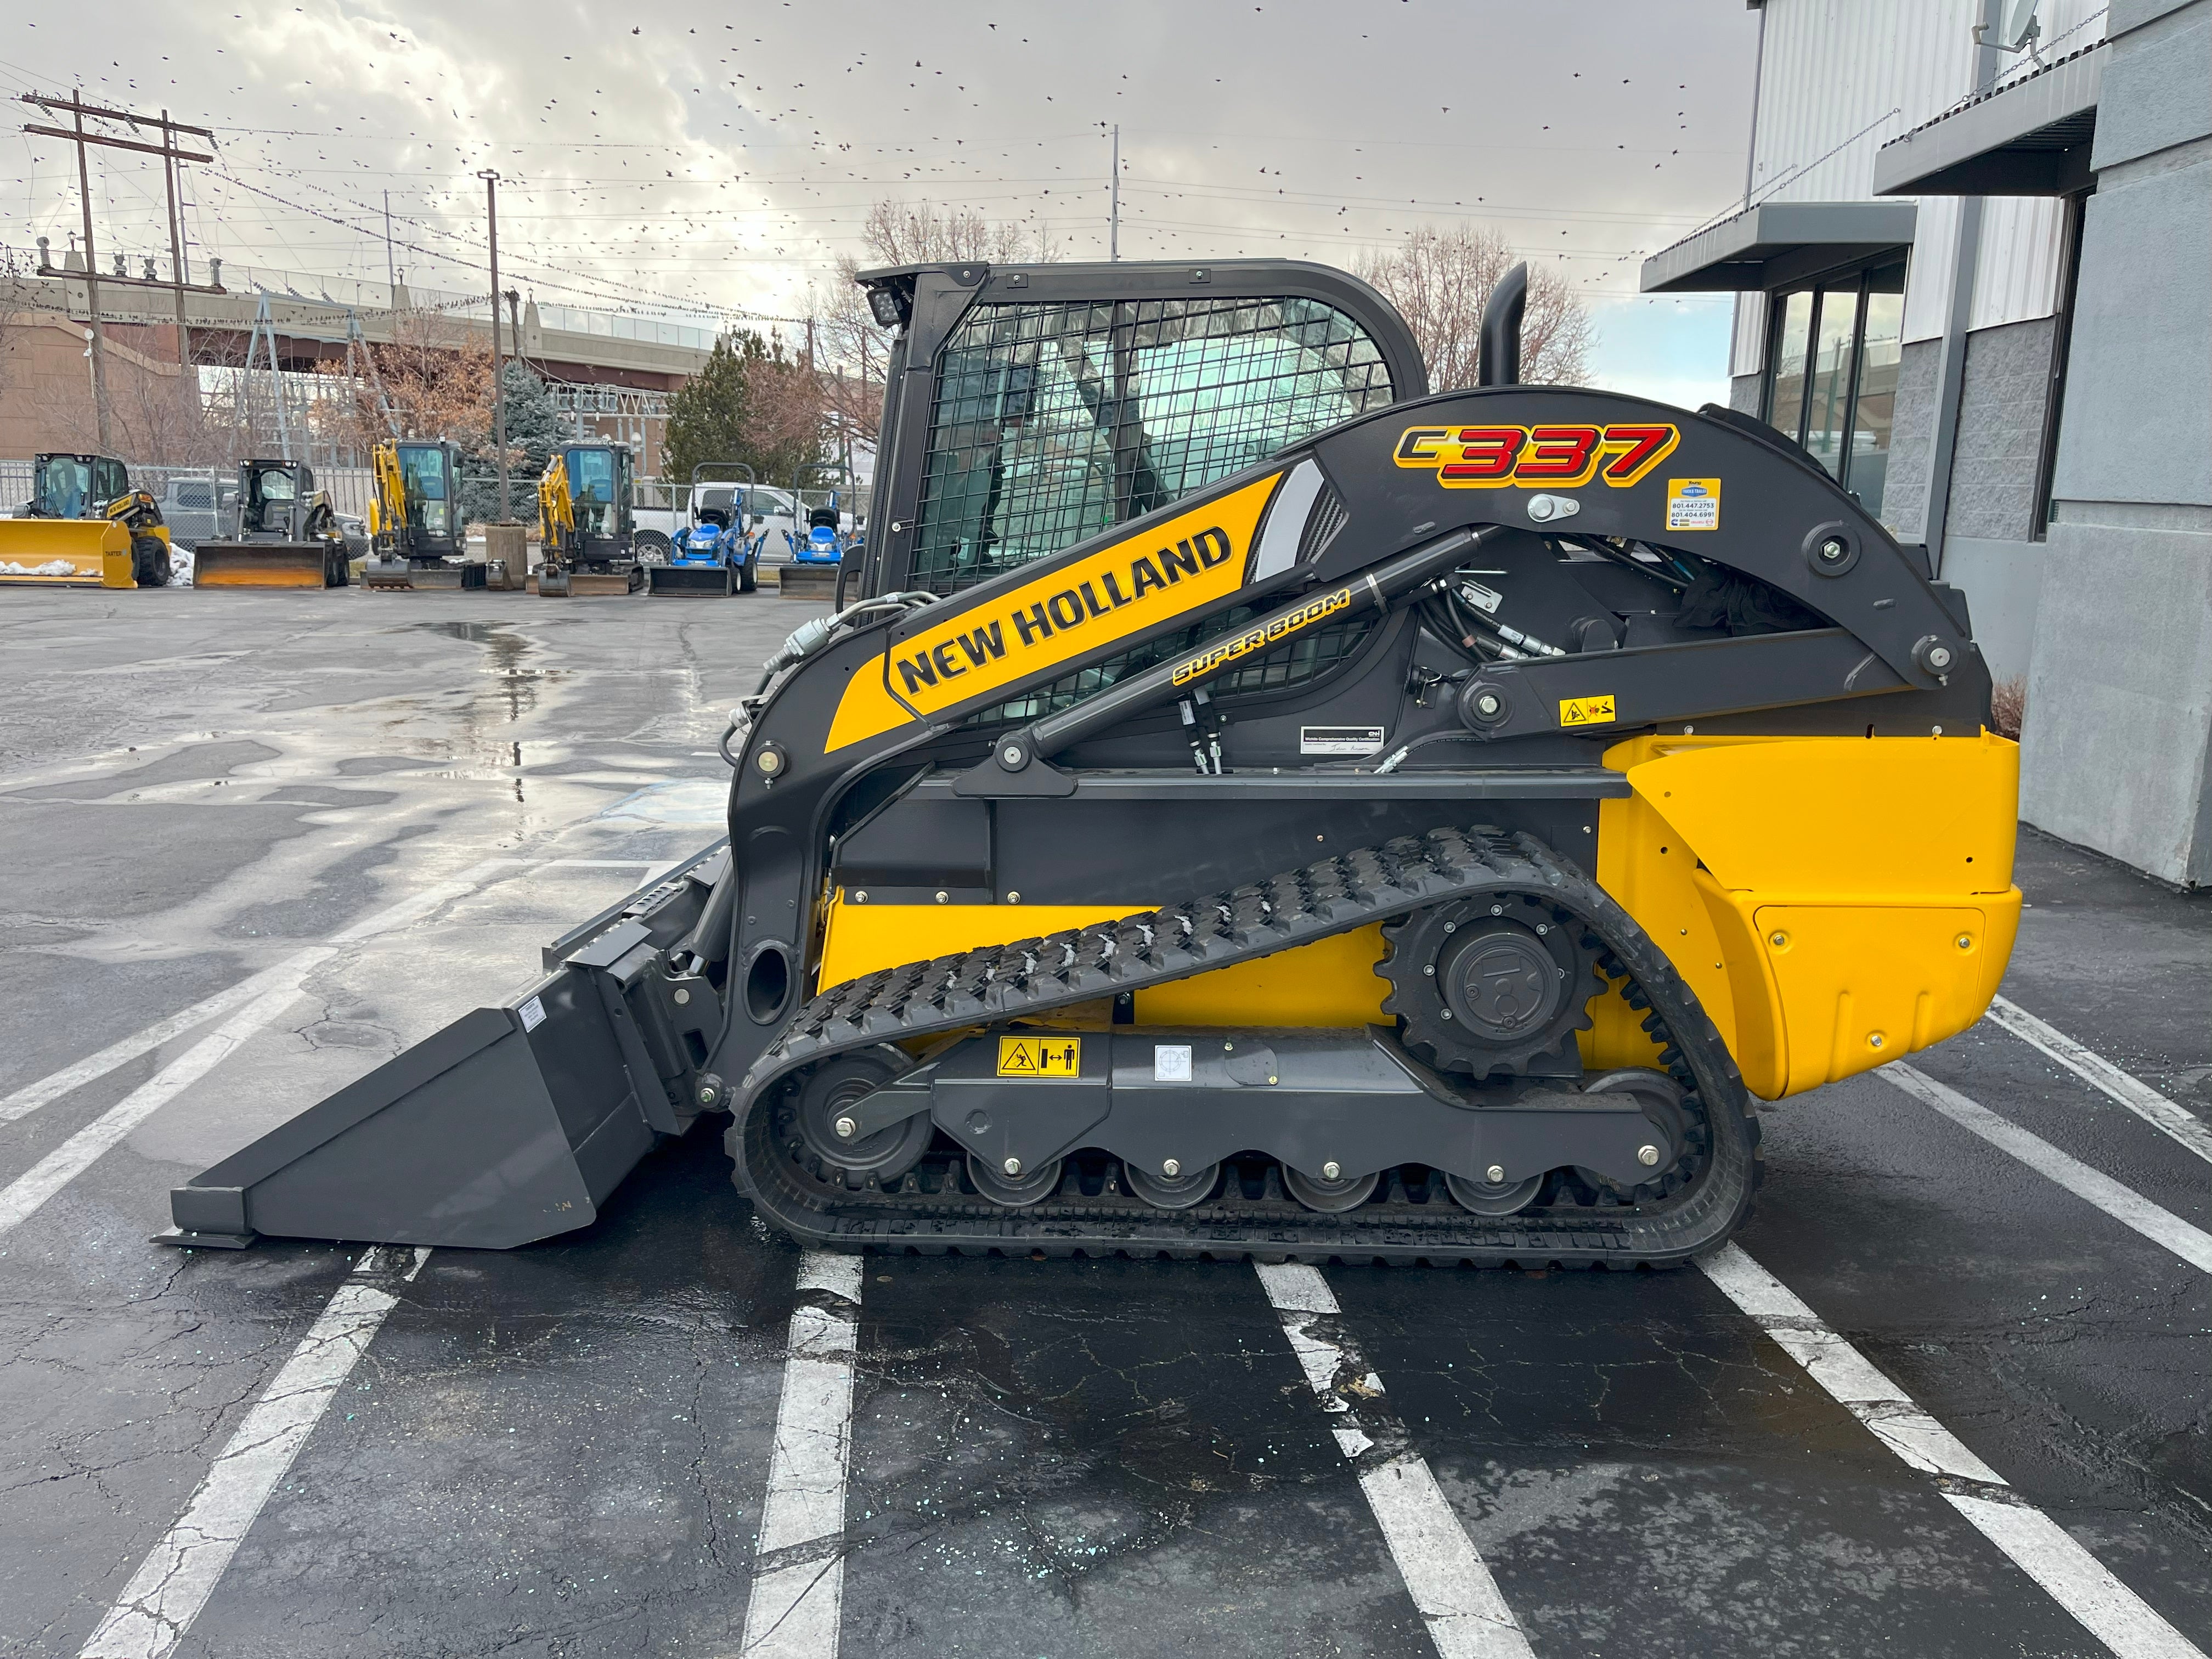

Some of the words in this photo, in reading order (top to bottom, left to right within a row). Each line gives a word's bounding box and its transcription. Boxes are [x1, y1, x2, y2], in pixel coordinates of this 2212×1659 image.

[895, 619, 1007, 695] NEW
[1011, 525, 1234, 647] HOLLAND
[1172, 629, 1265, 685] SUPER
[1267, 589, 1350, 641] BOOM
